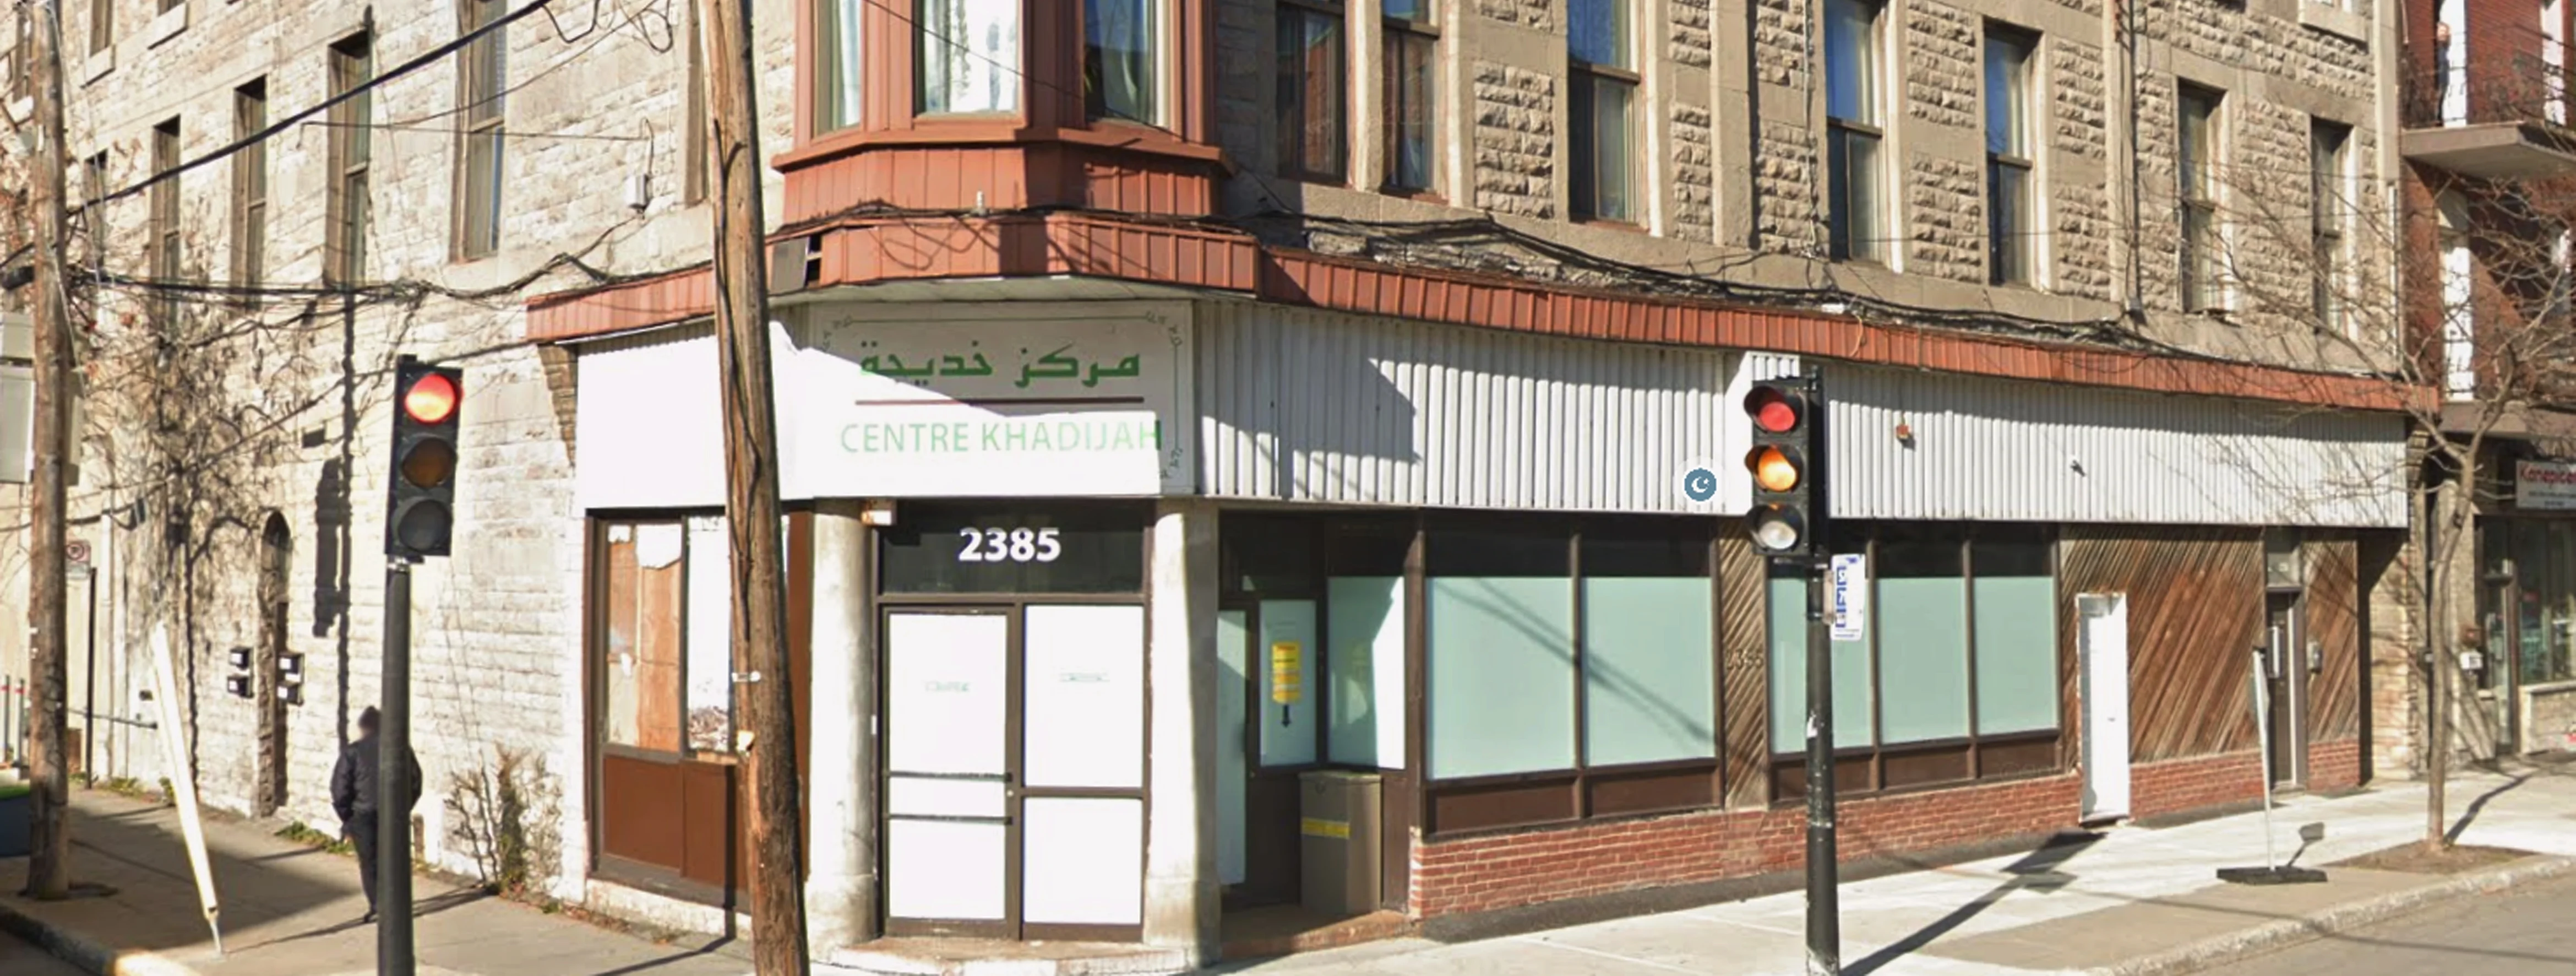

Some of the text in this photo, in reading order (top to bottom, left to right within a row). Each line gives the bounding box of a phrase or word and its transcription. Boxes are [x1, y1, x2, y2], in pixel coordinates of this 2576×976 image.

[861, 340, 1140, 388] مركز خديجة
[840, 419, 1162, 454] CENTRE KHADIJAH
[958, 527, 1061, 561] 2385
